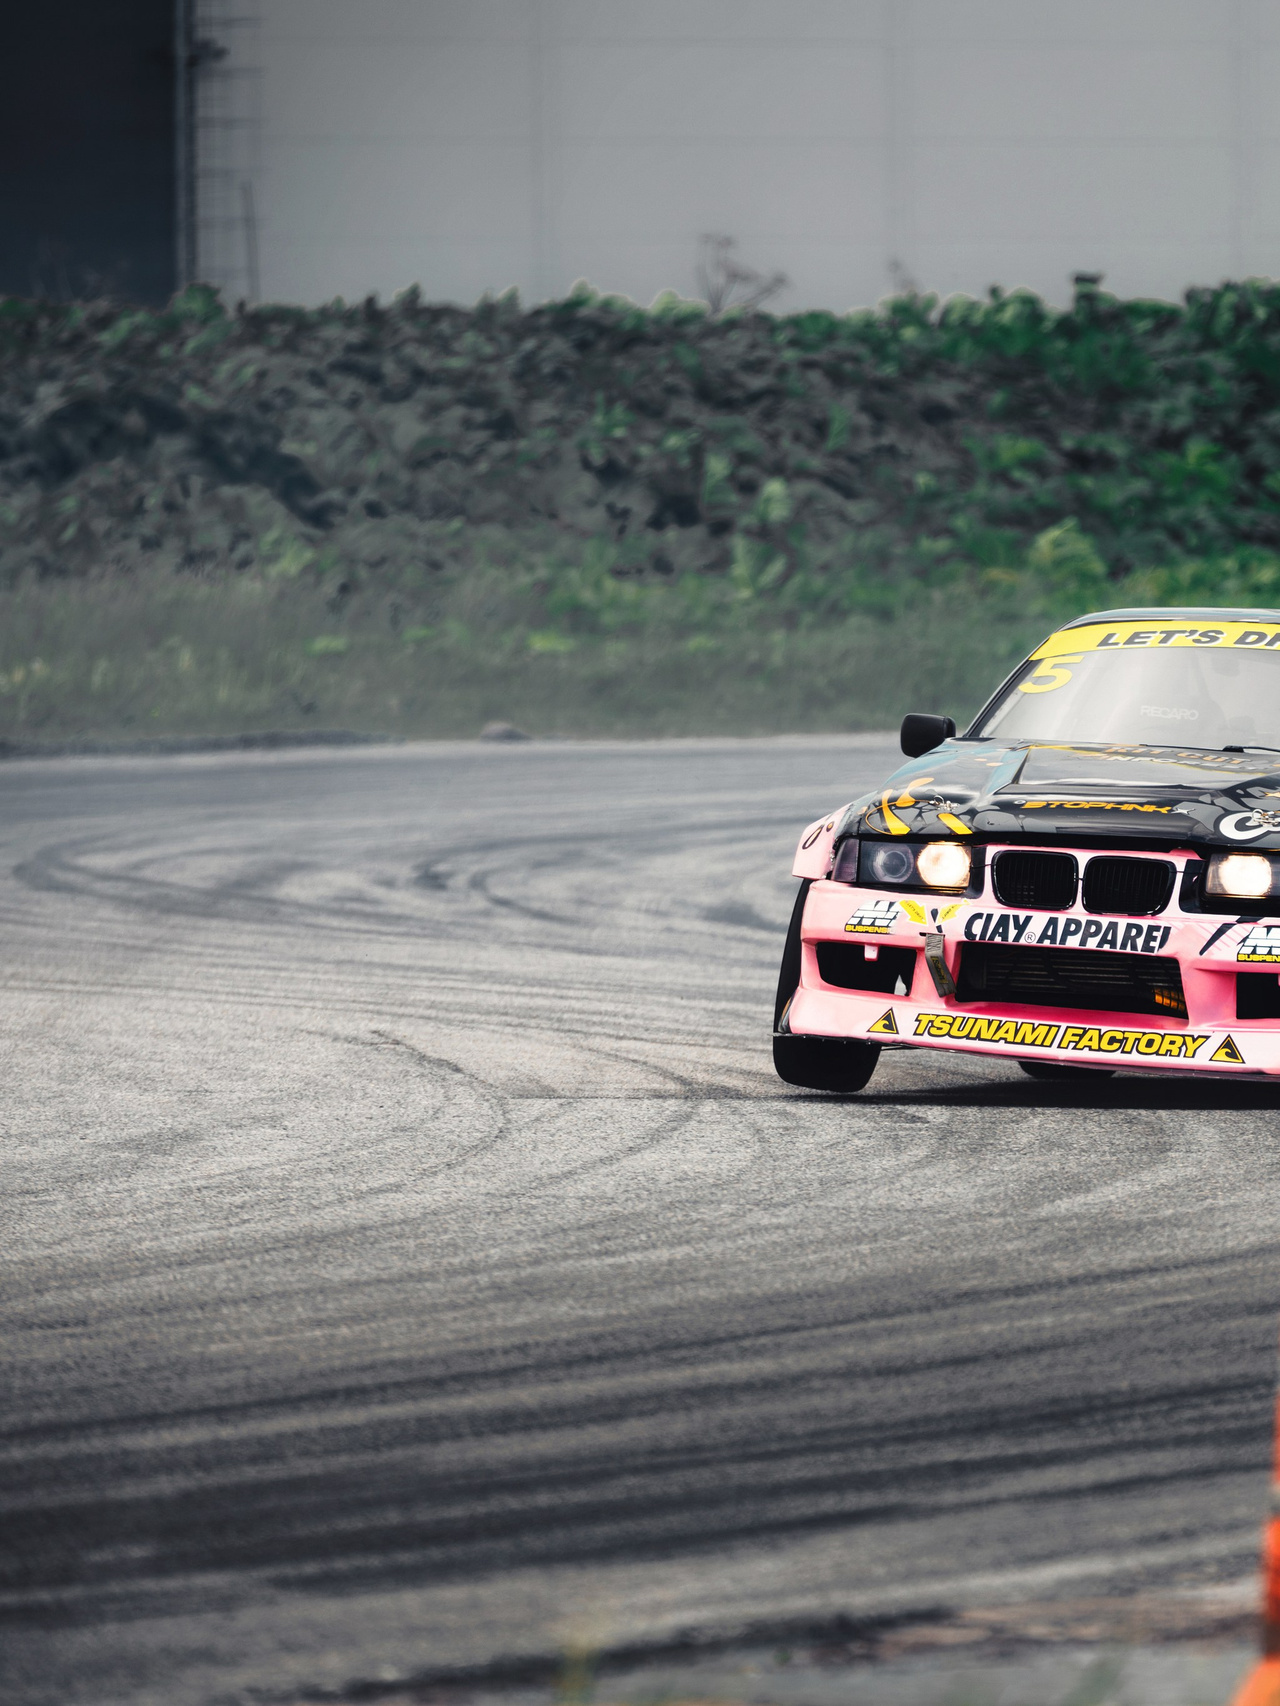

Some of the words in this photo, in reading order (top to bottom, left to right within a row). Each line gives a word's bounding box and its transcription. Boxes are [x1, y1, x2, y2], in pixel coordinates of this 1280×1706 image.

[1096, 629, 1225, 647] LET'S
[1019, 655, 1084, 693] 5
[1140, 705, 1199, 721] RECARO
[914, 1014, 1058, 1047] TSUNAMI
[1060, 1024, 1210, 1057] FACTORY
